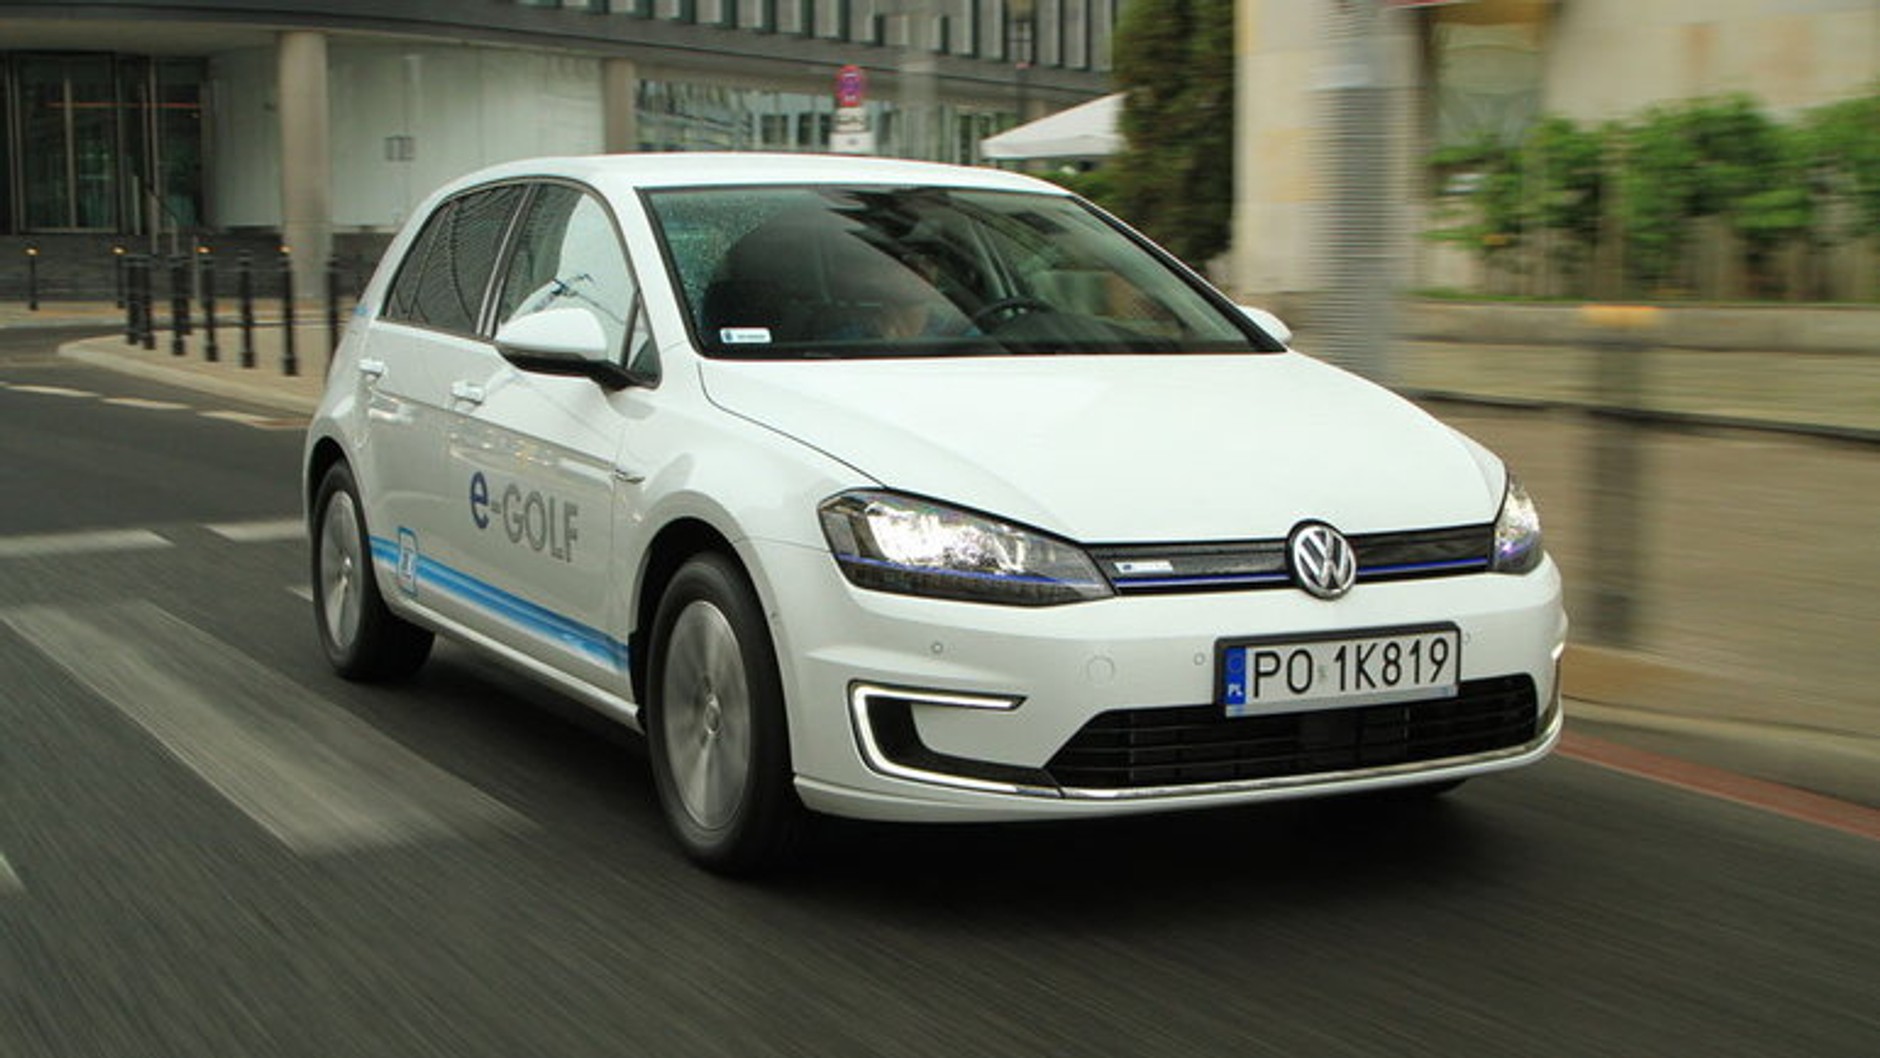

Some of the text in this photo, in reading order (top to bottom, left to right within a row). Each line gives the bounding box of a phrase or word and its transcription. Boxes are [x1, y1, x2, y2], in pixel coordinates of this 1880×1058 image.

[470, 471, 579, 563] e-GOLF
[1227, 683, 1243, 697] PL
[1253, 637, 1450, 698] PO 1K819
